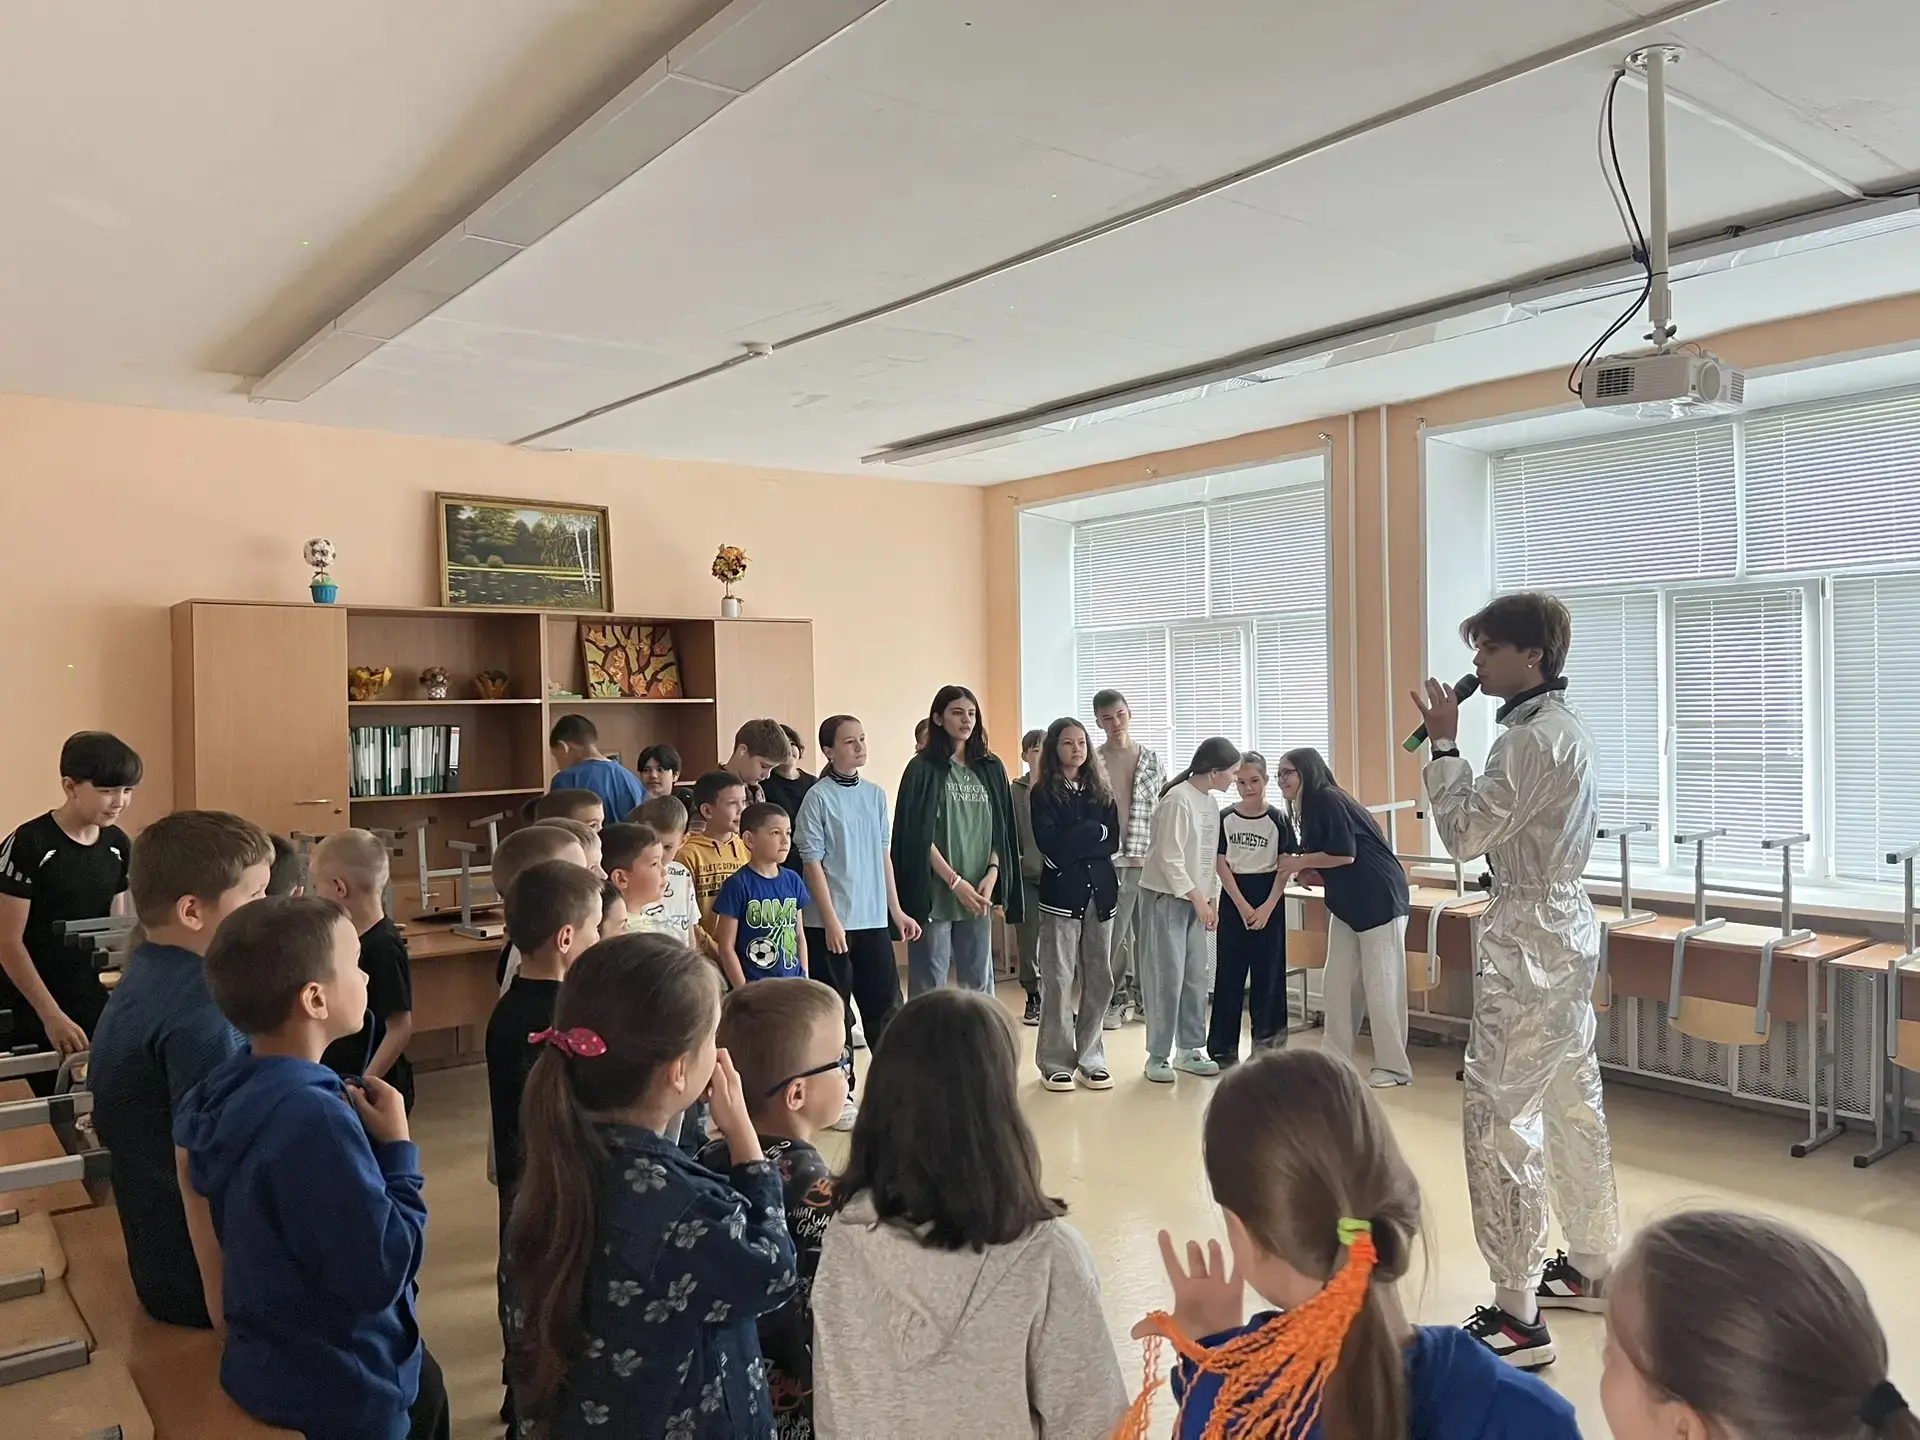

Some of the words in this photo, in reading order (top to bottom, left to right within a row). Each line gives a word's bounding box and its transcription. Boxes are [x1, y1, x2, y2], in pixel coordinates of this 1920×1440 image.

[1229, 832, 1268, 848] MANCHESTER
[699, 863, 722, 872] THLETIC
[746, 898, 797, 929] GAME
[812, 1213, 831, 1229] WA
[796, 1219, 824, 1242] GREA
[776, 1411, 792, 1427] HAT
